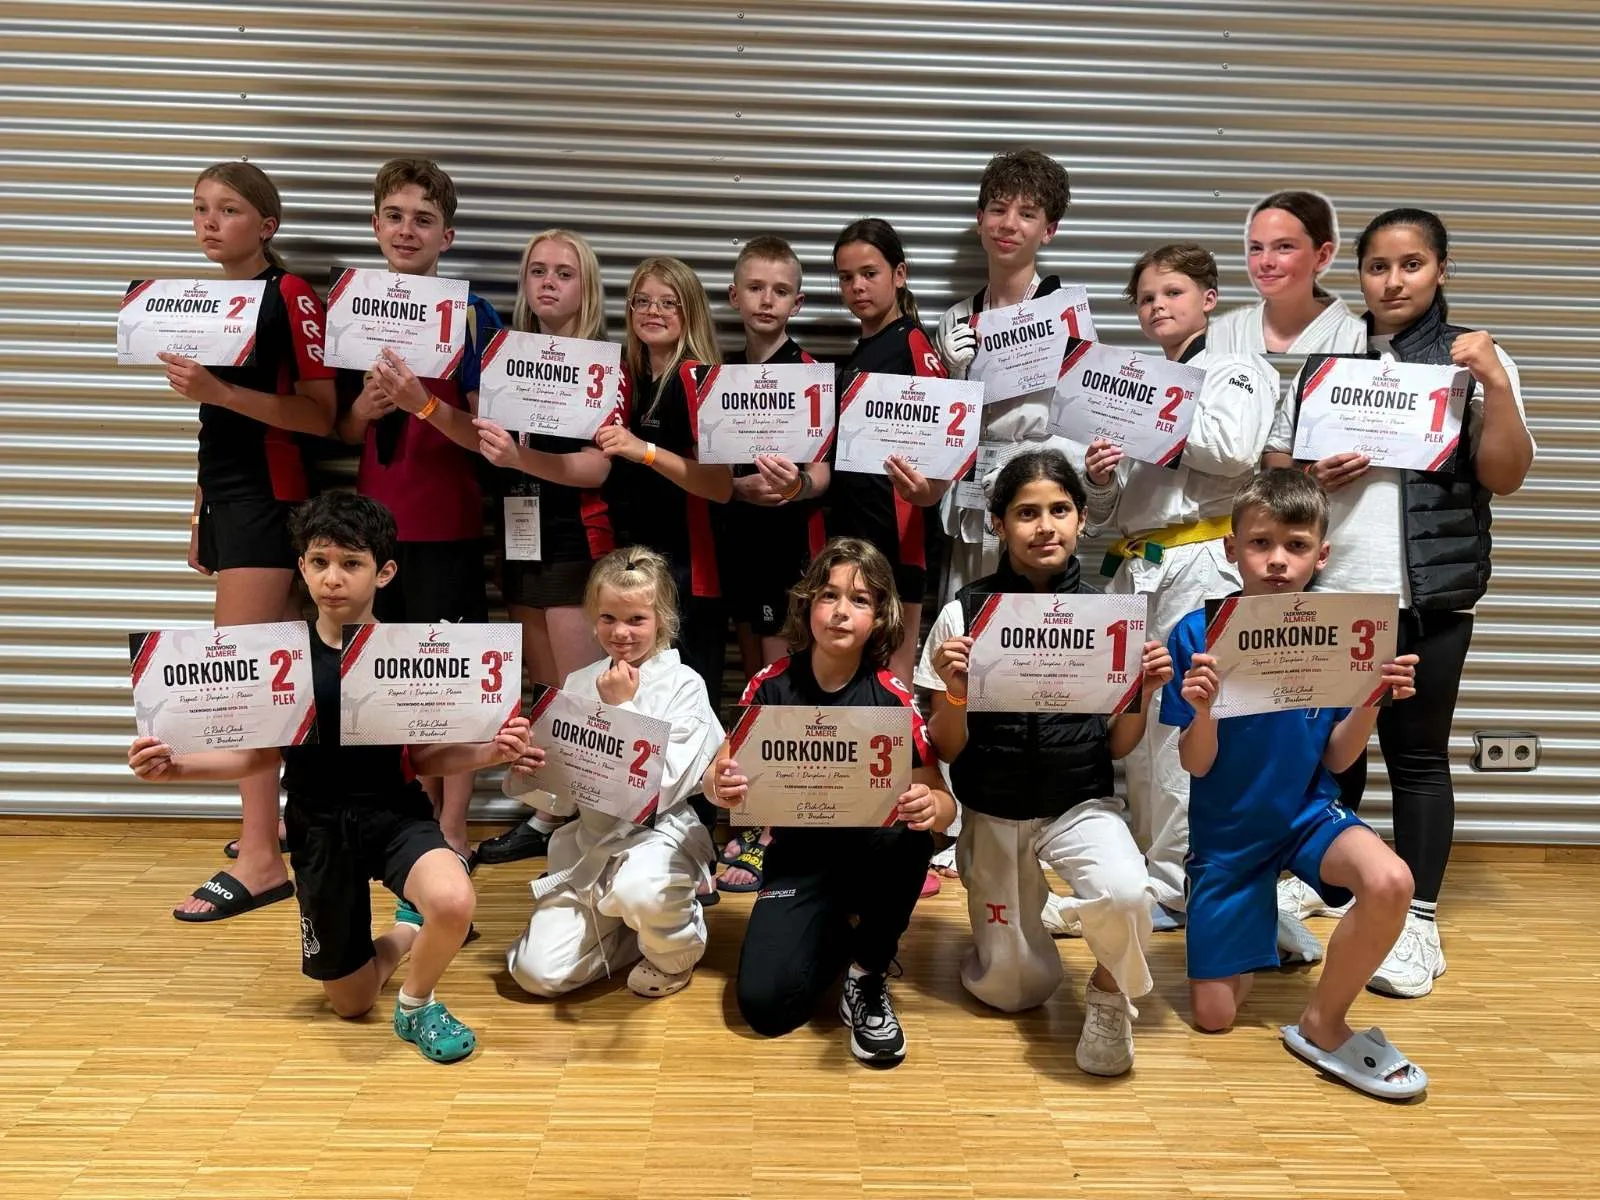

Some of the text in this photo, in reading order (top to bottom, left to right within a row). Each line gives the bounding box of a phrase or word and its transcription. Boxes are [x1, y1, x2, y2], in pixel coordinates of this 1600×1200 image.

[146, 298, 221, 313] OORKONDE
[352, 297, 427, 322] OORKONDE
[224, 325, 241, 333] PLEK
[984, 320, 1054, 352] OORKONDE
[436, 344, 452, 353] PLEK
[506, 359, 580, 384] OORKONDE
[1082, 370, 1156, 405] OORKONDE
[585, 399, 601, 408] PLEK
[722, 392, 795, 409] OORKONDE
[1331, 386, 1418, 411] OORKONDE
[866, 400, 940, 423] OORKONDE
[807, 429, 822, 437] PLEK
[1156, 420, 1174, 434] PLEK
[946, 438, 963, 448] PLEK
[1424, 433, 1444, 443] PLEK
[1001, 627, 1095, 649] OORKONDE
[1239, 626, 1338, 651] OORKONDE
[206, 650, 237, 658] ALMERE
[163, 659, 259, 687] OORKONDE
[375, 658, 470, 679] OORKONDE
[1351, 661, 1373, 672] PLEK
[1107, 673, 1127, 684] PLEK
[273, 694, 295, 706] PLEK
[482, 693, 502, 703] PLEK
[552, 719, 624, 758] OORKONDE
[762, 740, 857, 762] OORKONDE
[628, 776, 646, 789] PLEK
[870, 778, 891, 789] PLEK
[202, 881, 234, 900] mbro
